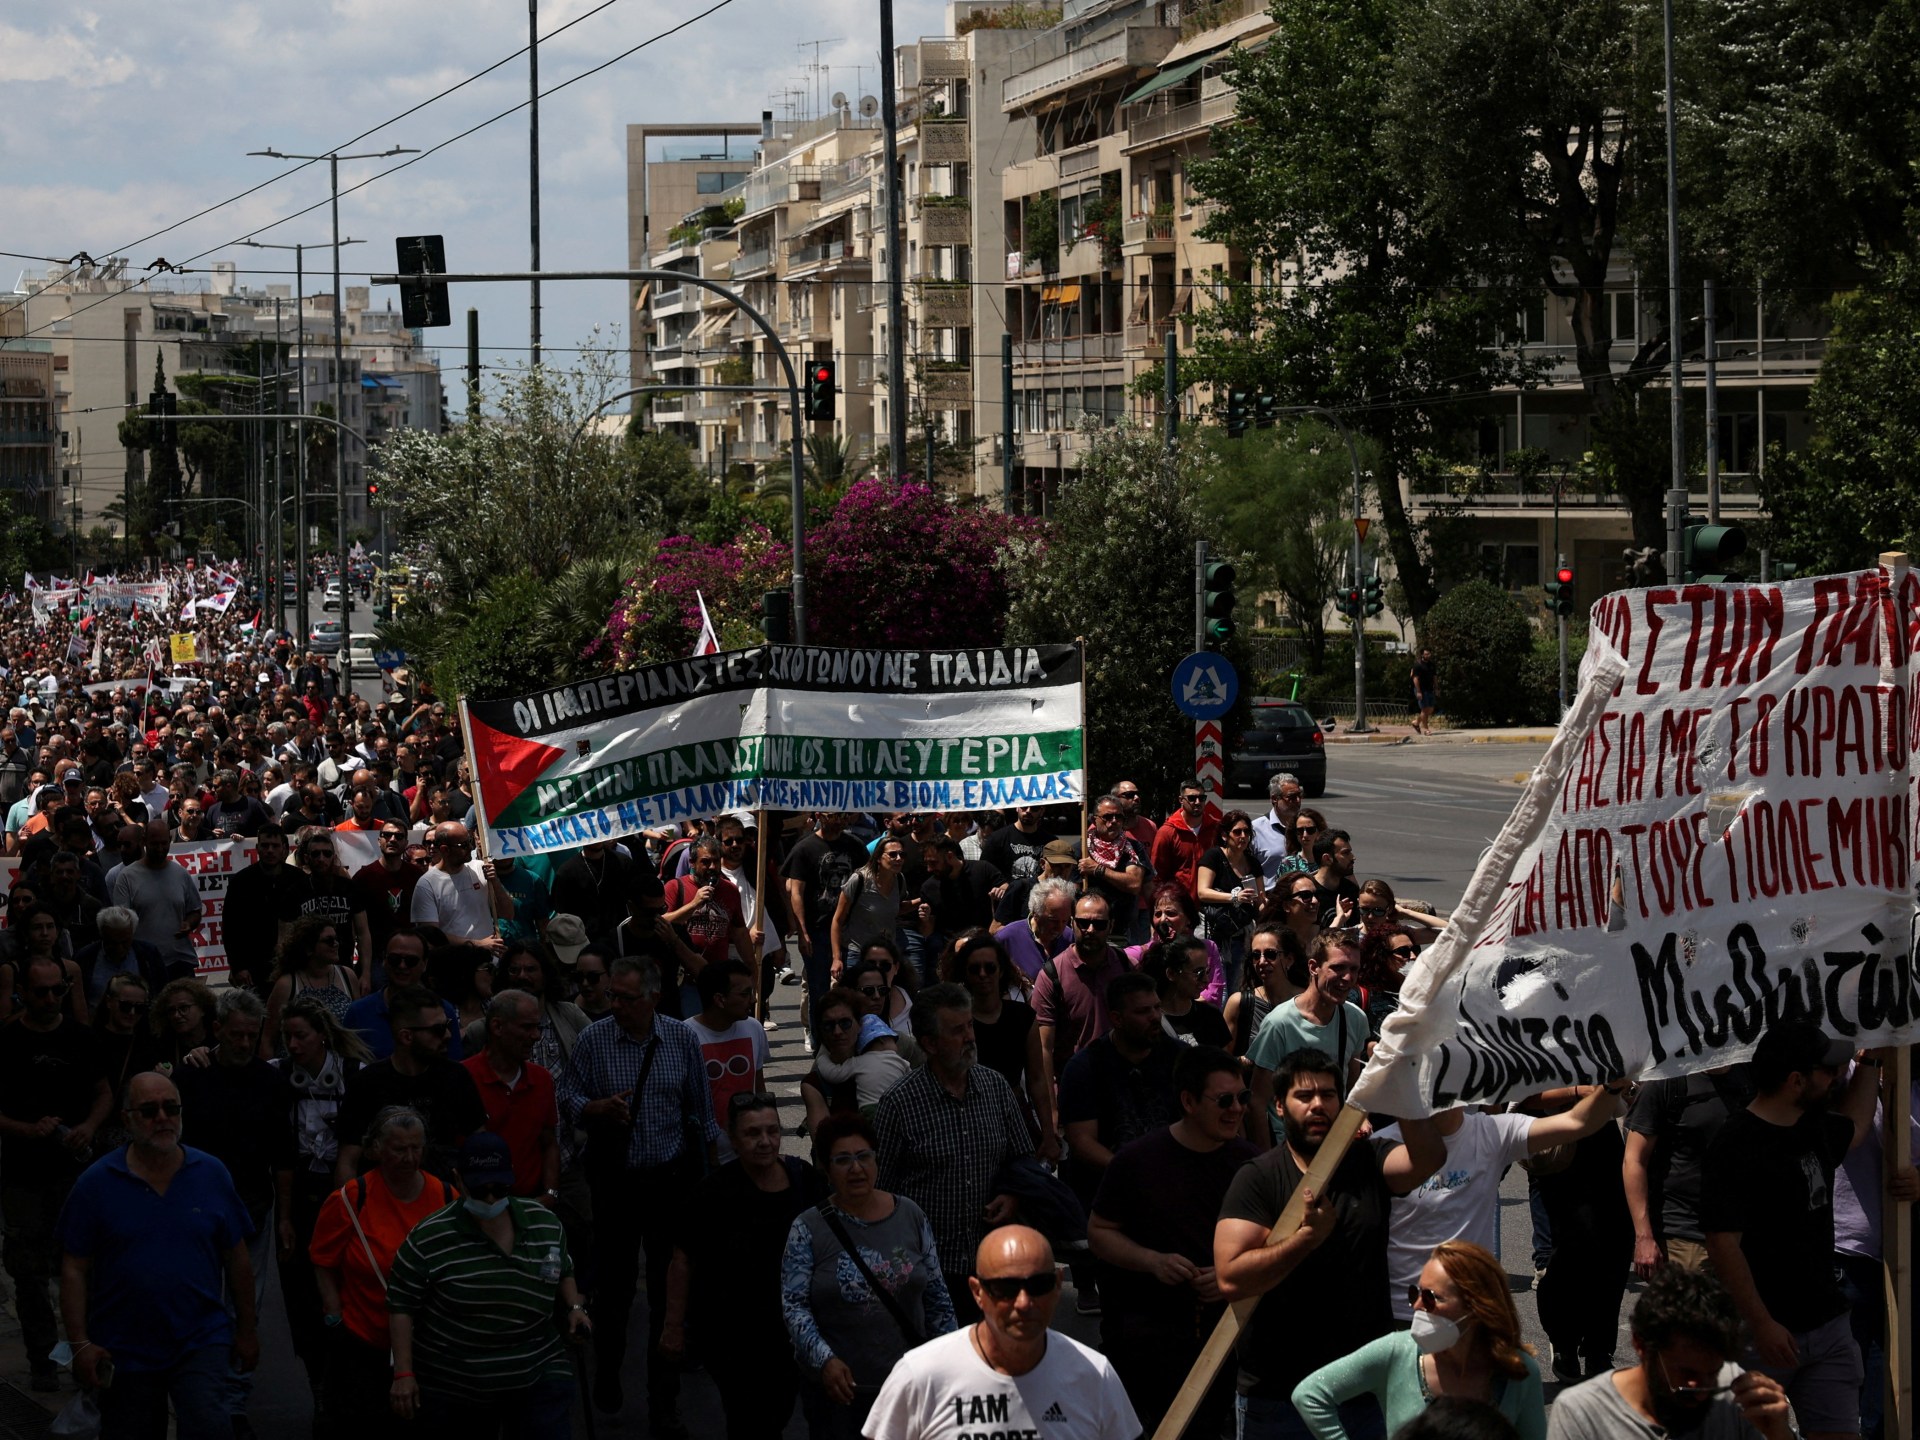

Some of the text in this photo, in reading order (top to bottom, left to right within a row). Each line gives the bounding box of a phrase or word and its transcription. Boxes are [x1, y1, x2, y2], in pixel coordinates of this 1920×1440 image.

[1638, 585, 1783, 696] ΣΤΗΝ
[512, 697, 542, 735] ΟΙ
[542, 649, 763, 726] ΙΜΠΕΡΙΑΛΙΣΤΕΣ
[930, 647, 1047, 686] ΠΑΙΔΙΑ
[537, 779, 577, 817] ΜΕ
[577, 760, 635, 804] ΤΗΝ
[647, 736, 794, 788] ΠΑΛΑΙΣΤΙΝΗ
[832, 739, 863, 774] ΤΗ
[873, 736, 1047, 776] ΛΕΥΤΕΡΙΑ
[1655, 708, 1712, 800] ΜΕ
[1727, 693, 1770, 782] ΤΟ
[497, 808, 611, 855] ΣΥΝΔΙΚΑΤΟ
[964, 770, 1074, 809] ΕΛΛΑΔΑΣ
[1554, 827, 1614, 931] ΑΠΟ
[1620, 810, 1716, 920] ΤΟΥΣ
[1723, 793, 1911, 904] ΠΟΛΕΜΙΚ
[956, 1393, 1009, 1426] I AM
[1042, 1414, 1067, 1423] adidas
